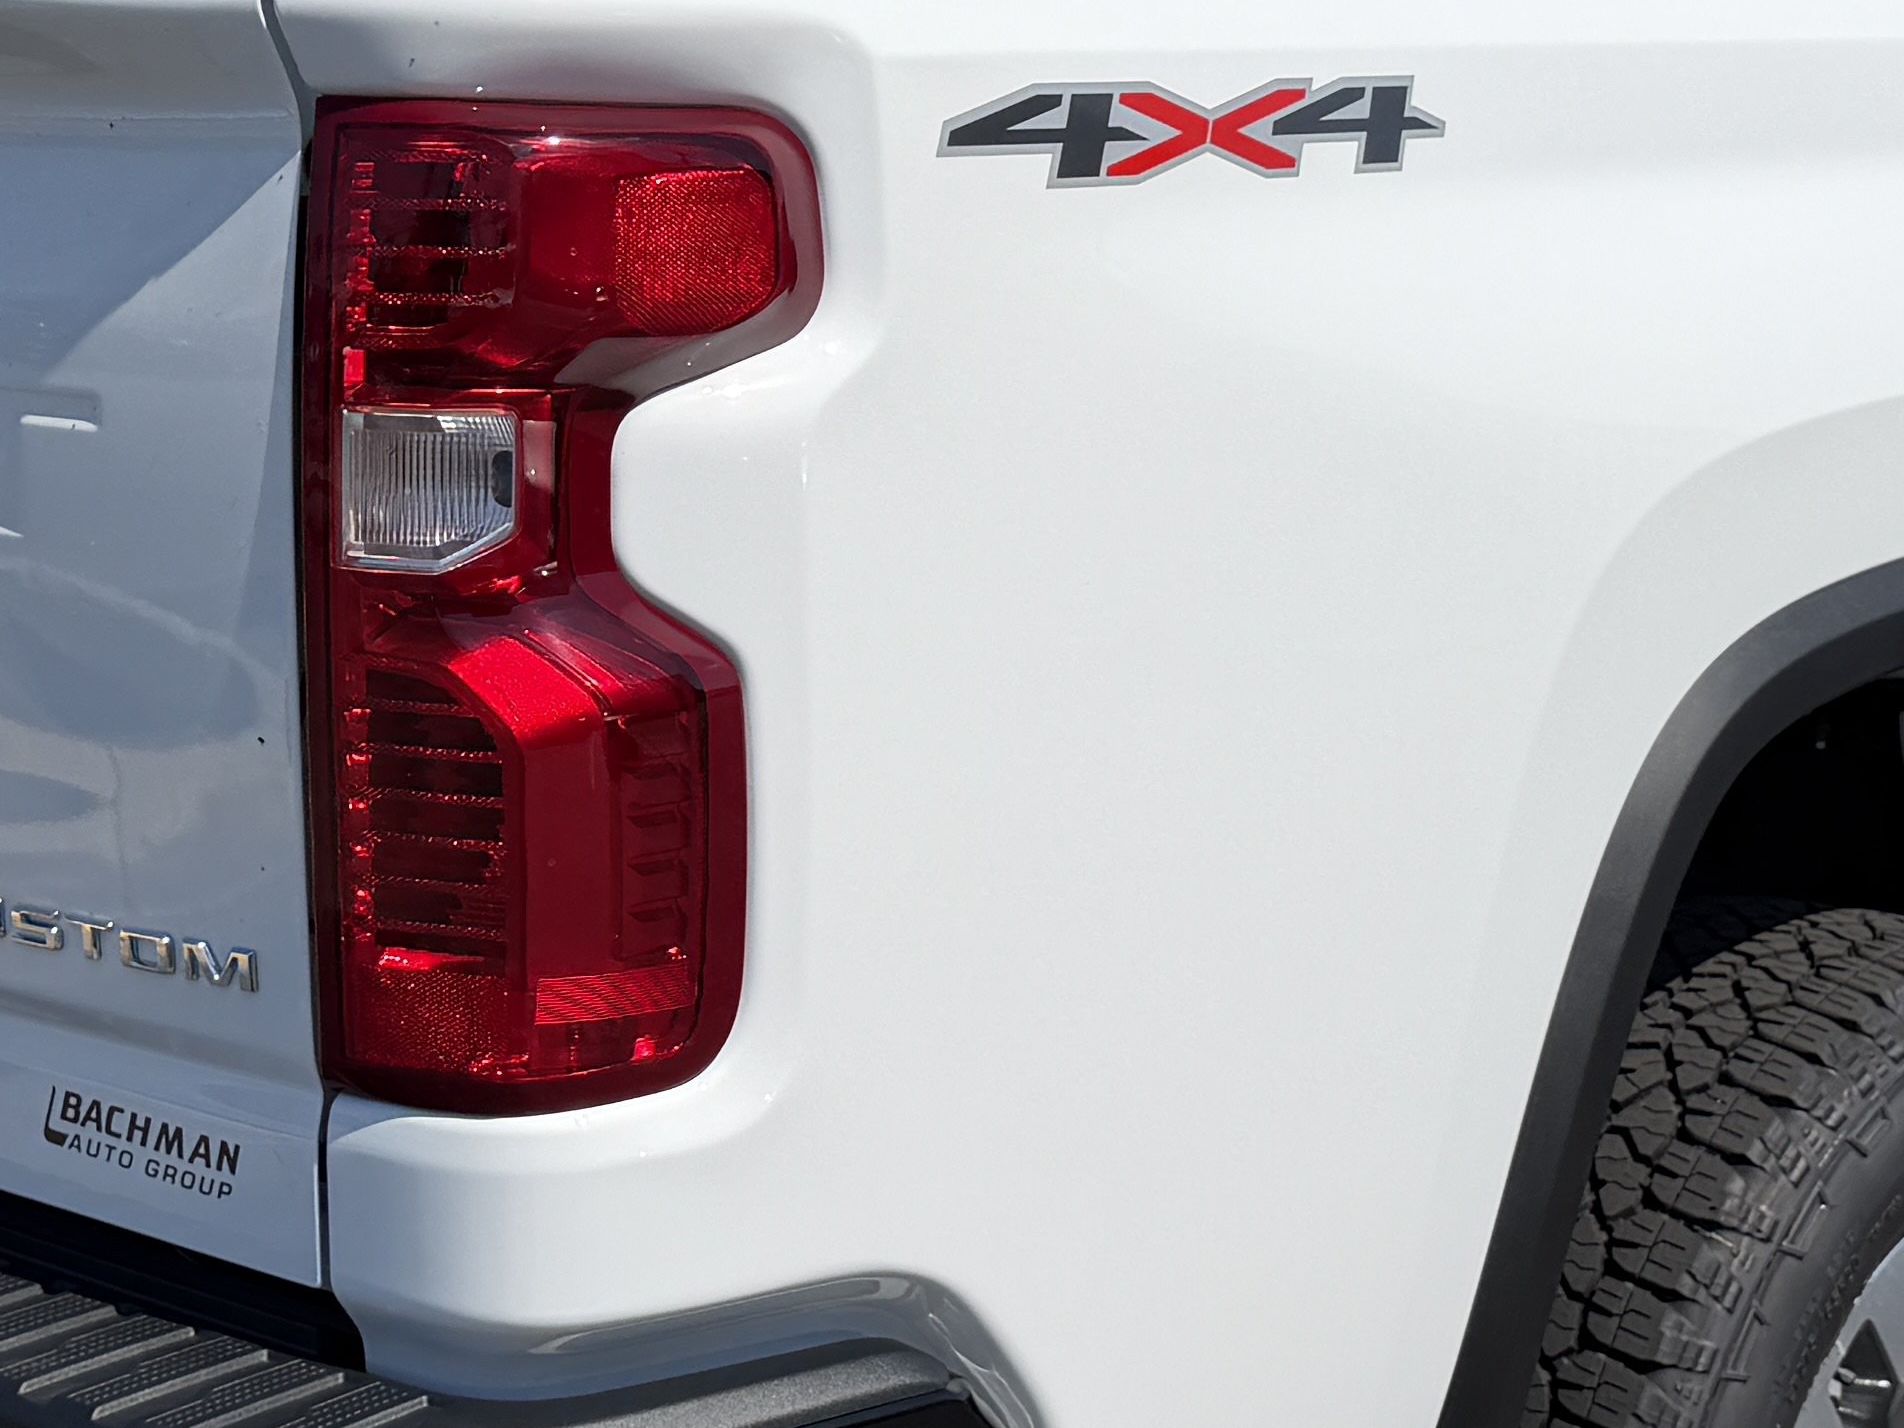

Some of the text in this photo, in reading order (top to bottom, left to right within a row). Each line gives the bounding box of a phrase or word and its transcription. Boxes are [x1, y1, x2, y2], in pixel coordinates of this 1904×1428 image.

[938, 76, 1444, 188] 4X4
[60, 1090, 241, 1176] BACHMAN
[68, 1134, 233, 1199] AUTO GROUP
